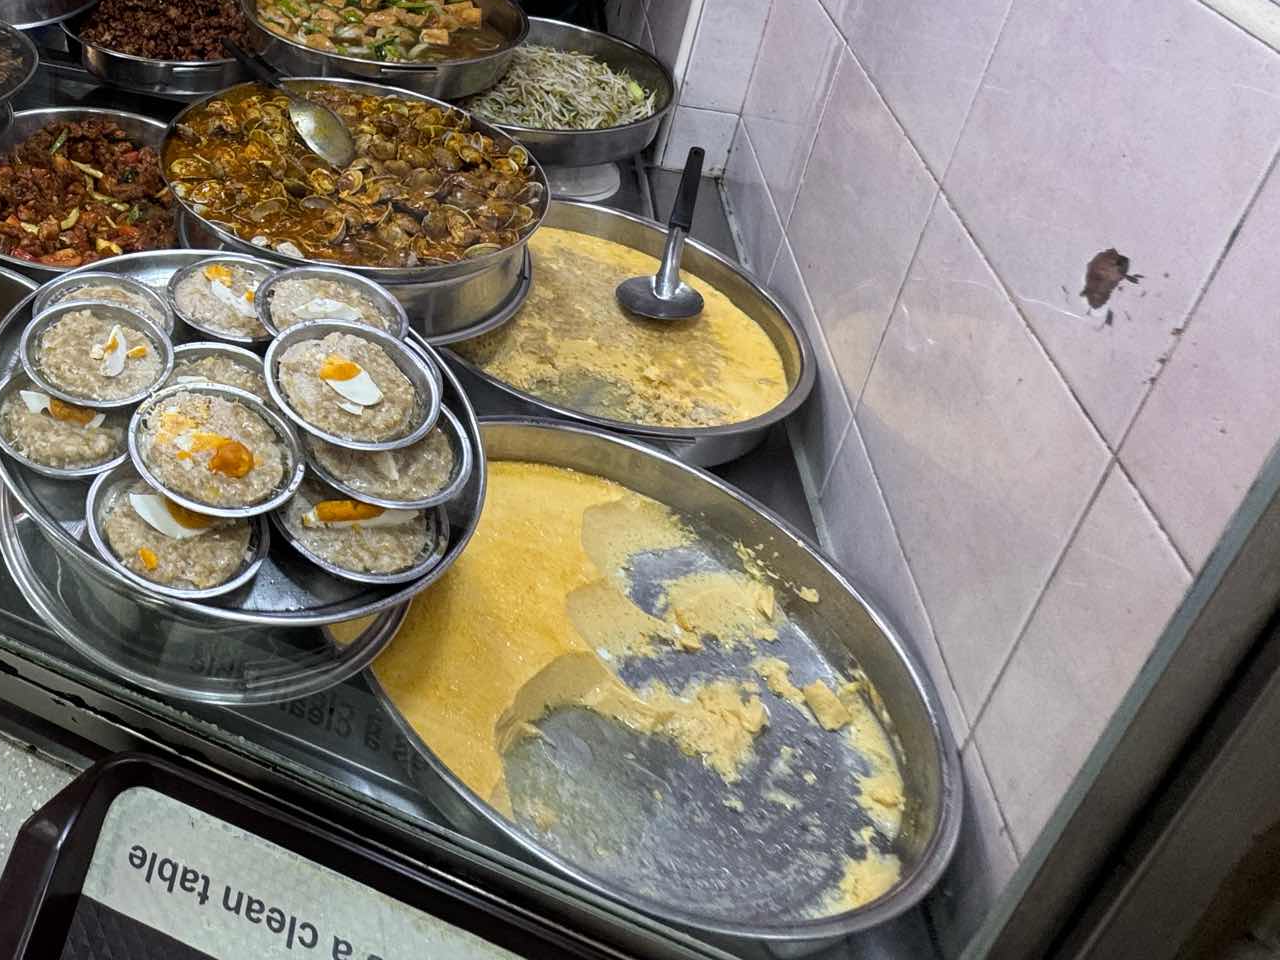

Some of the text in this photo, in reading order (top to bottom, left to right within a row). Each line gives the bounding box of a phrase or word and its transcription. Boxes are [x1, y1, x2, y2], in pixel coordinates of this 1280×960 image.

[128, 844, 353, 960] a clean table
